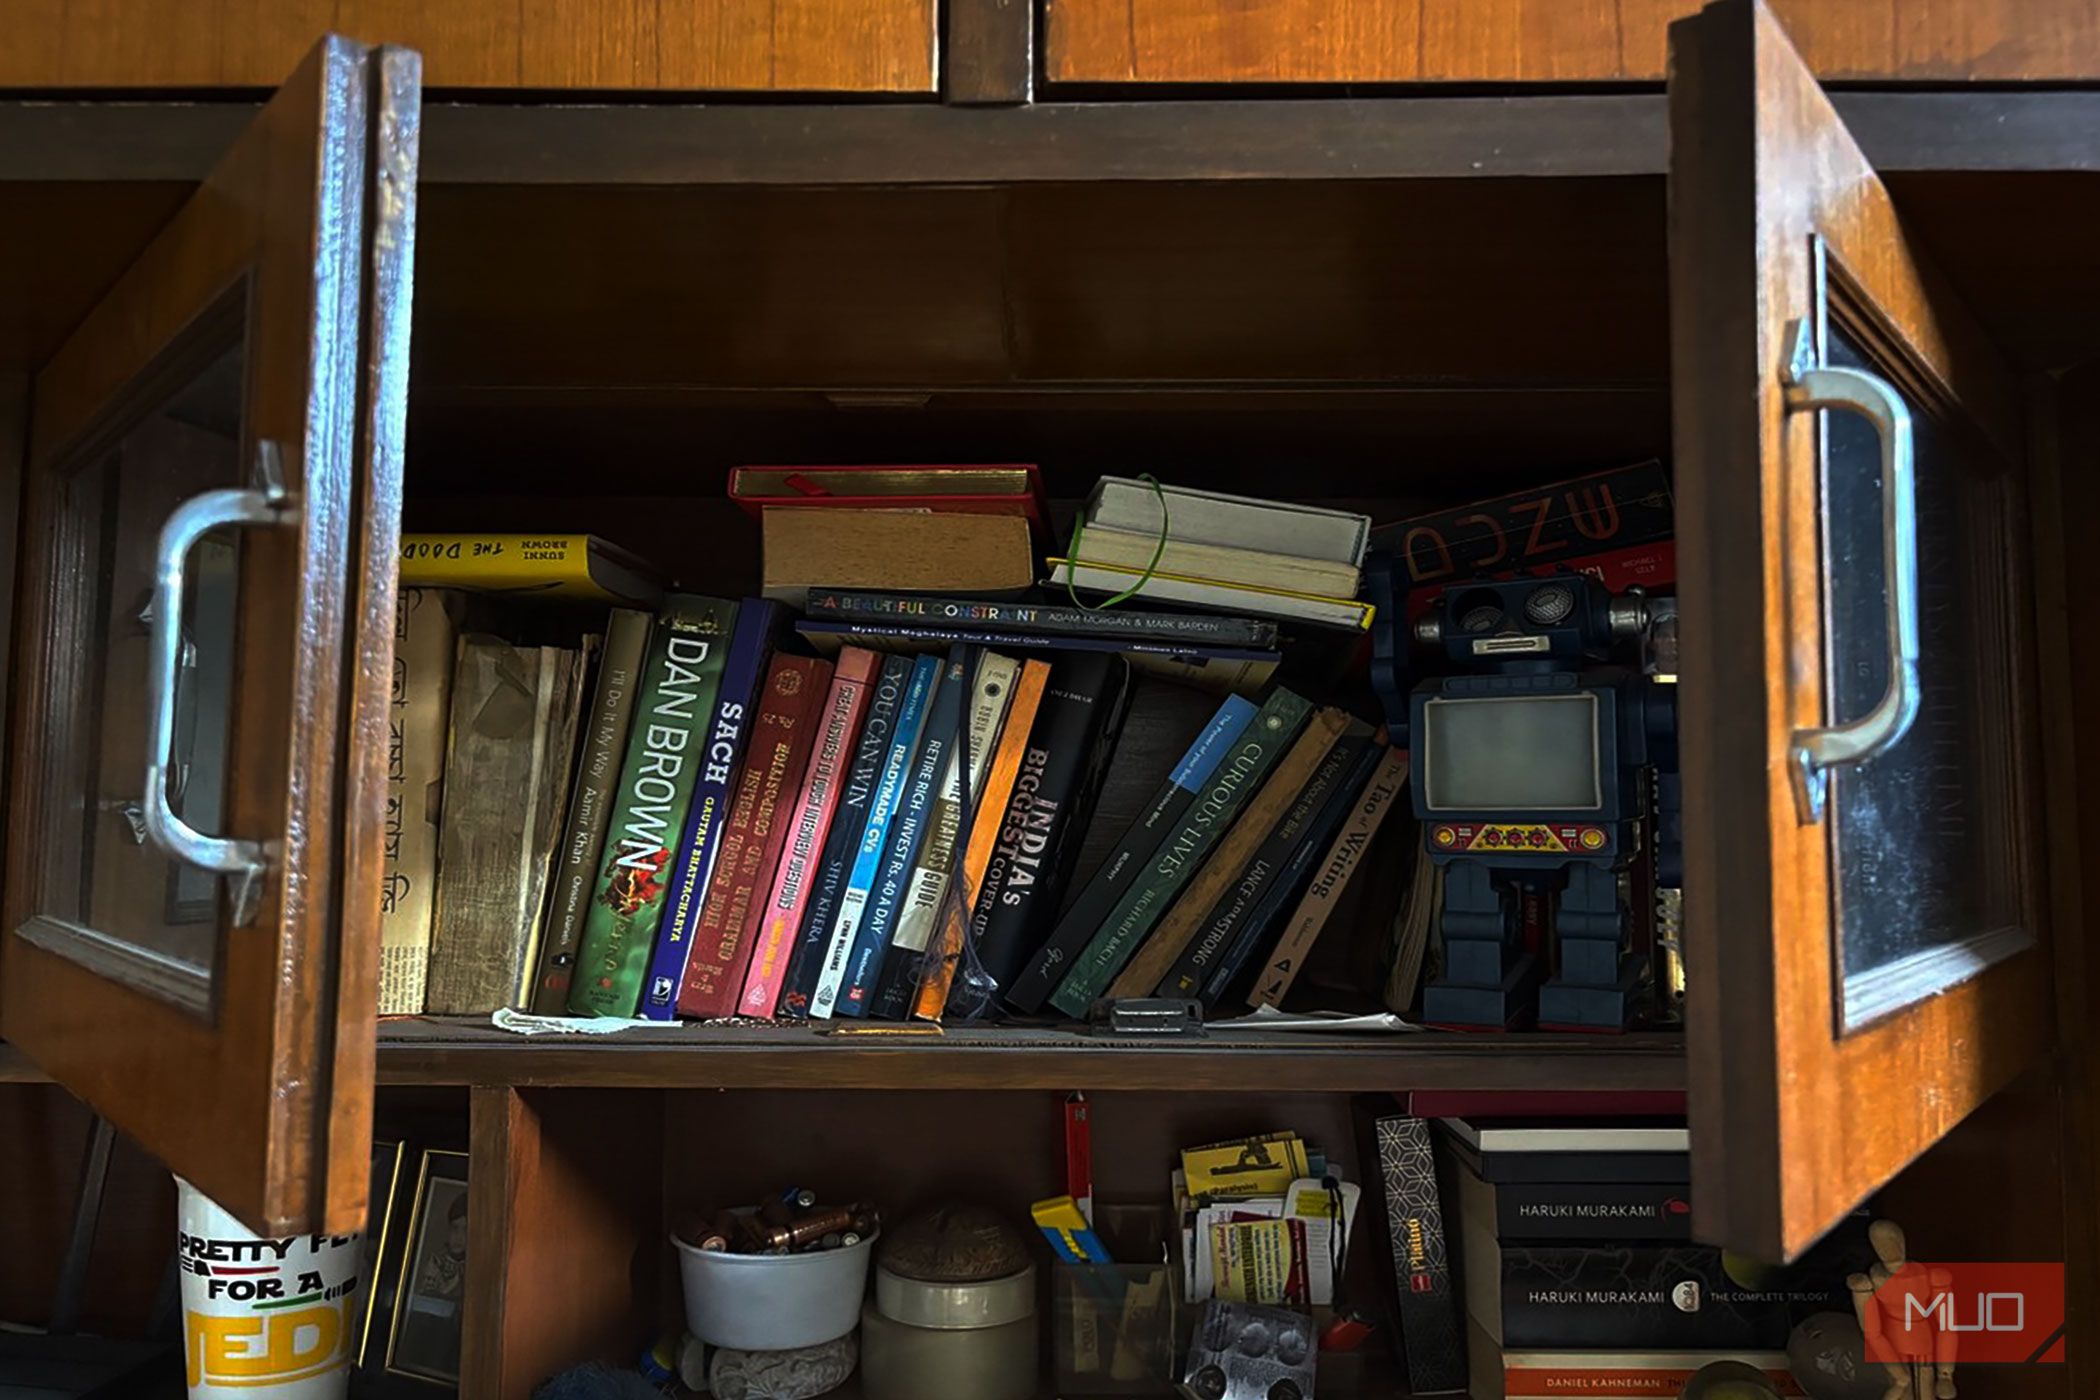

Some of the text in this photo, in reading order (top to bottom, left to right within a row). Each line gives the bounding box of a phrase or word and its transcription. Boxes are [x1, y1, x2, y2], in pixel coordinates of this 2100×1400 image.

[473, 542, 504, 557] THE
[521, 540, 567, 549] BROWN
[822, 595, 1038, 622] A BEAUTIFUL CONSTRAINT
[1048, 612, 1081, 624] ADAM
[1082, 615, 1131, 628] MORGAN
[1146, 619, 1175, 630] MARK
[1178, 620, 1219, 633] BARDEN
[850, 624, 899, 636] Mystical
[606, 690, 623, 709] Do
[603, 711, 618, 723] It
[595, 725, 615, 748] My
[704, 701, 744, 785] SACH
[847, 672, 903, 809] YOU CAN WIN
[588, 751, 610, 780] Way
[616, 637, 709, 873] DAN BROWN
[918, 738, 943, 782] RETIRE
[578, 786, 598, 827] Aamir
[742, 845, 763, 876] AND
[753, 742, 792, 837] COMPOSITION
[862, 743, 907, 854] READYMADE CVs
[910, 779, 930, 812] RICH
[1156, 742, 1264, 879] CURIOUS LIVES
[1363, 783, 1397, 815] Tao
[571, 831, 589, 865] Khan
[894, 815, 918, 859] INVEST
[928, 801, 962, 870] GREATNESS
[975, 747, 1049, 936] BIGGEST COVER-UP
[1002, 796, 1058, 906] INDIA'S
[669, 796, 716, 942] GAUTAM BHATTACHARYA
[885, 859, 905, 880] Rs.
[1238, 859, 1271, 898] LANCE
[1311, 831, 1369, 899] Writing
[806, 859, 845, 945] SHIV KHERA
[876, 898, 890, 911] A
[881, 878, 898, 898] 40
[915, 871, 942, 909] GUIDE
[869, 909, 889, 935] DAY
[1095, 887, 1156, 967] RICHARD BACH
[1191, 896, 1246, 967] ARMSTRONG
[1519, 1204, 1656, 1217] HARUKI MURAKAMI
[180, 1231, 296, 1262] PRETTY
[208, 1271, 323, 1301] FOR A
[1528, 1290, 1665, 1304] HARUKI MURAKAMI
[1710, 1291, 1830, 1302] THE COMPLETE TRILOGY
[1546, 1378, 1590, 1388] DANIEL
[1592, 1378, 1661, 1389] KAHNEMAN
